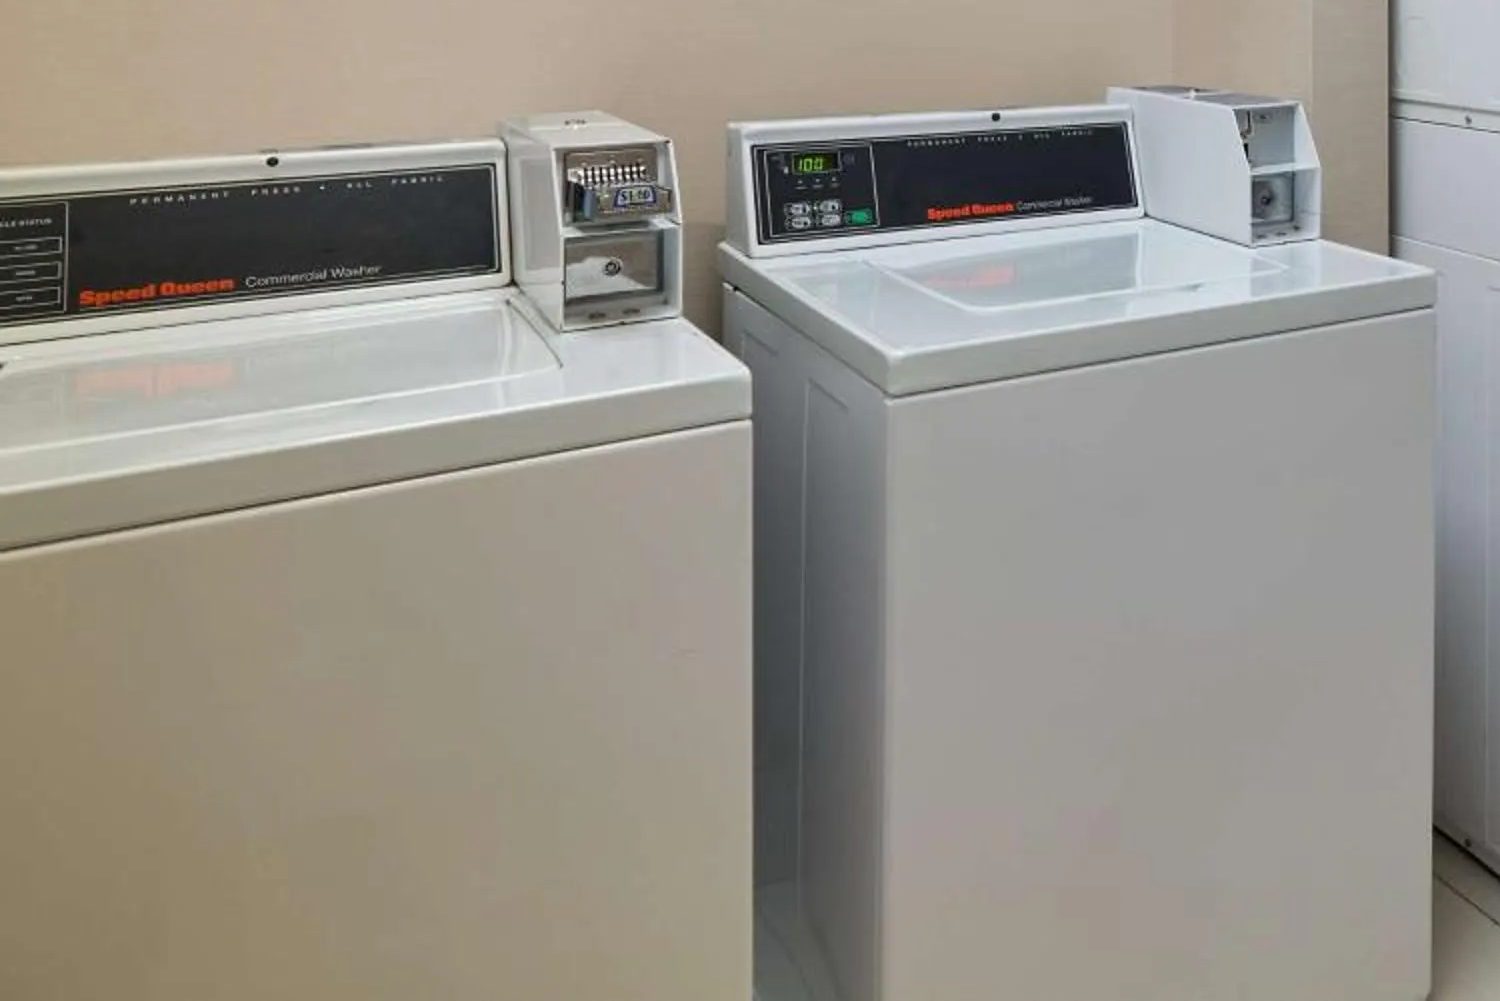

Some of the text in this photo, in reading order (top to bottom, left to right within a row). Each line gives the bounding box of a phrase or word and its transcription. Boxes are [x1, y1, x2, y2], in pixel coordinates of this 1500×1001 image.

[927, 203, 971, 221] Speed
[972, 201, 1015, 216] Queen
[79, 264, 383, 308] Speed Queen Commercial Washer
